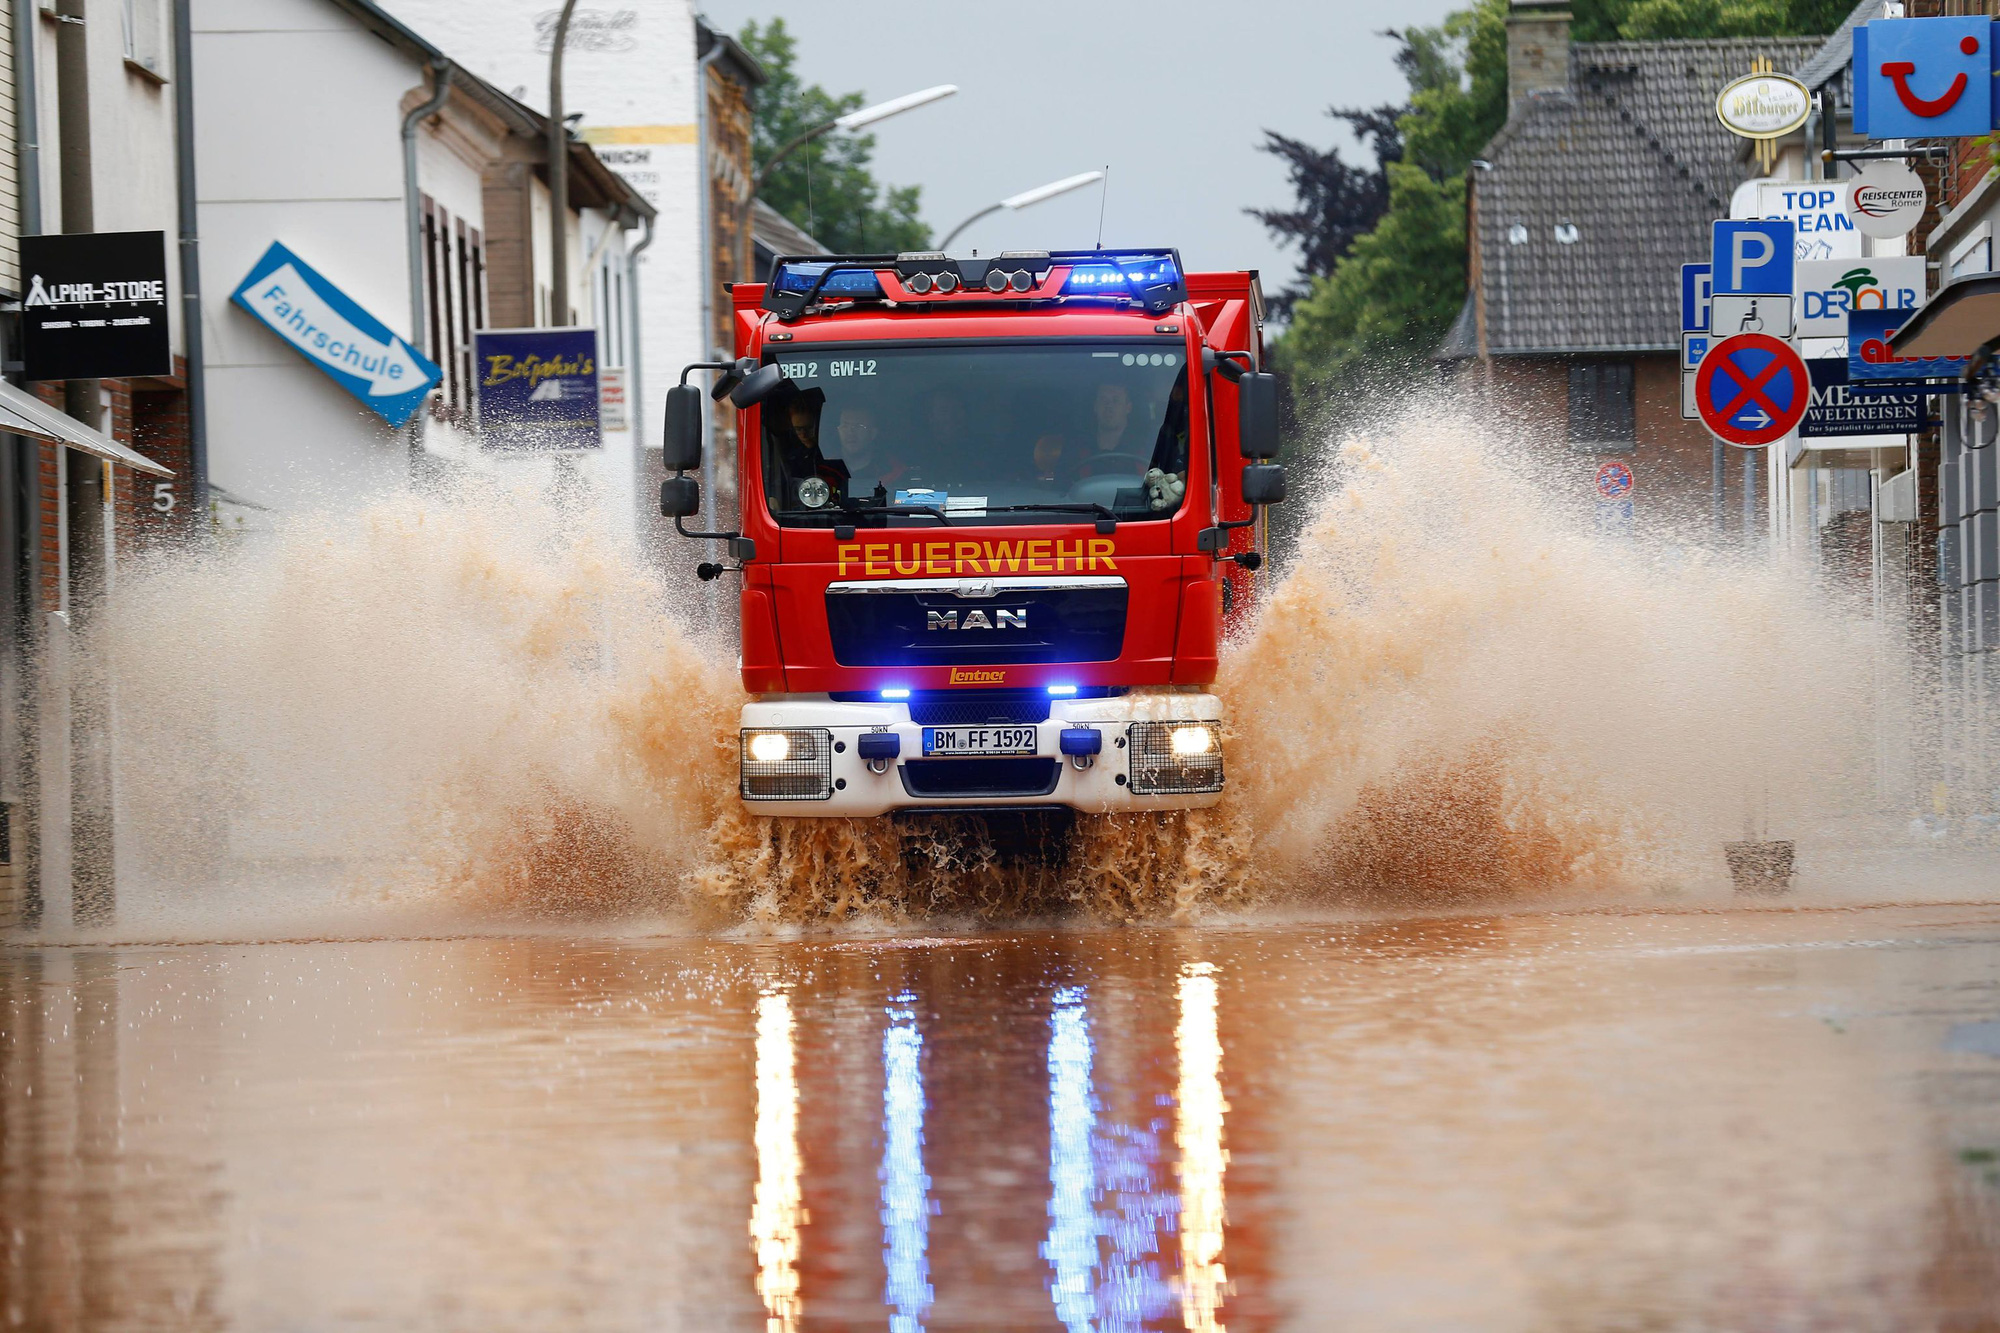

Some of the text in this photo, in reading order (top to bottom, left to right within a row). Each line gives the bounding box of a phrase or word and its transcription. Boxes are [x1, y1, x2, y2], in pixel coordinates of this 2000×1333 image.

[1782, 190, 1835, 210] TOP
[1861, 190, 1923, 201] REISECENTER
[1765, 213, 1854, 233] EAN
[1731, 231, 1774, 290] P
[262, 284, 404, 380] Fahrschule
[779, 359, 877, 379] BED 2 GW-L2
[1809, 405, 1917, 421] WELTREISEN
[1825, 424, 1861, 433] Spezialist
[1863, 422, 1875, 430] für
[1877, 422, 1895, 430] alles
[152, 484, 176, 512] 5
[838, 538, 1118, 576] FEUERWEHR
[927, 608, 1027, 630] MAN
[935, 731, 956, 749] BM
[968, 731, 989, 748] FF
[993, 729, 1034, 748] 1592
